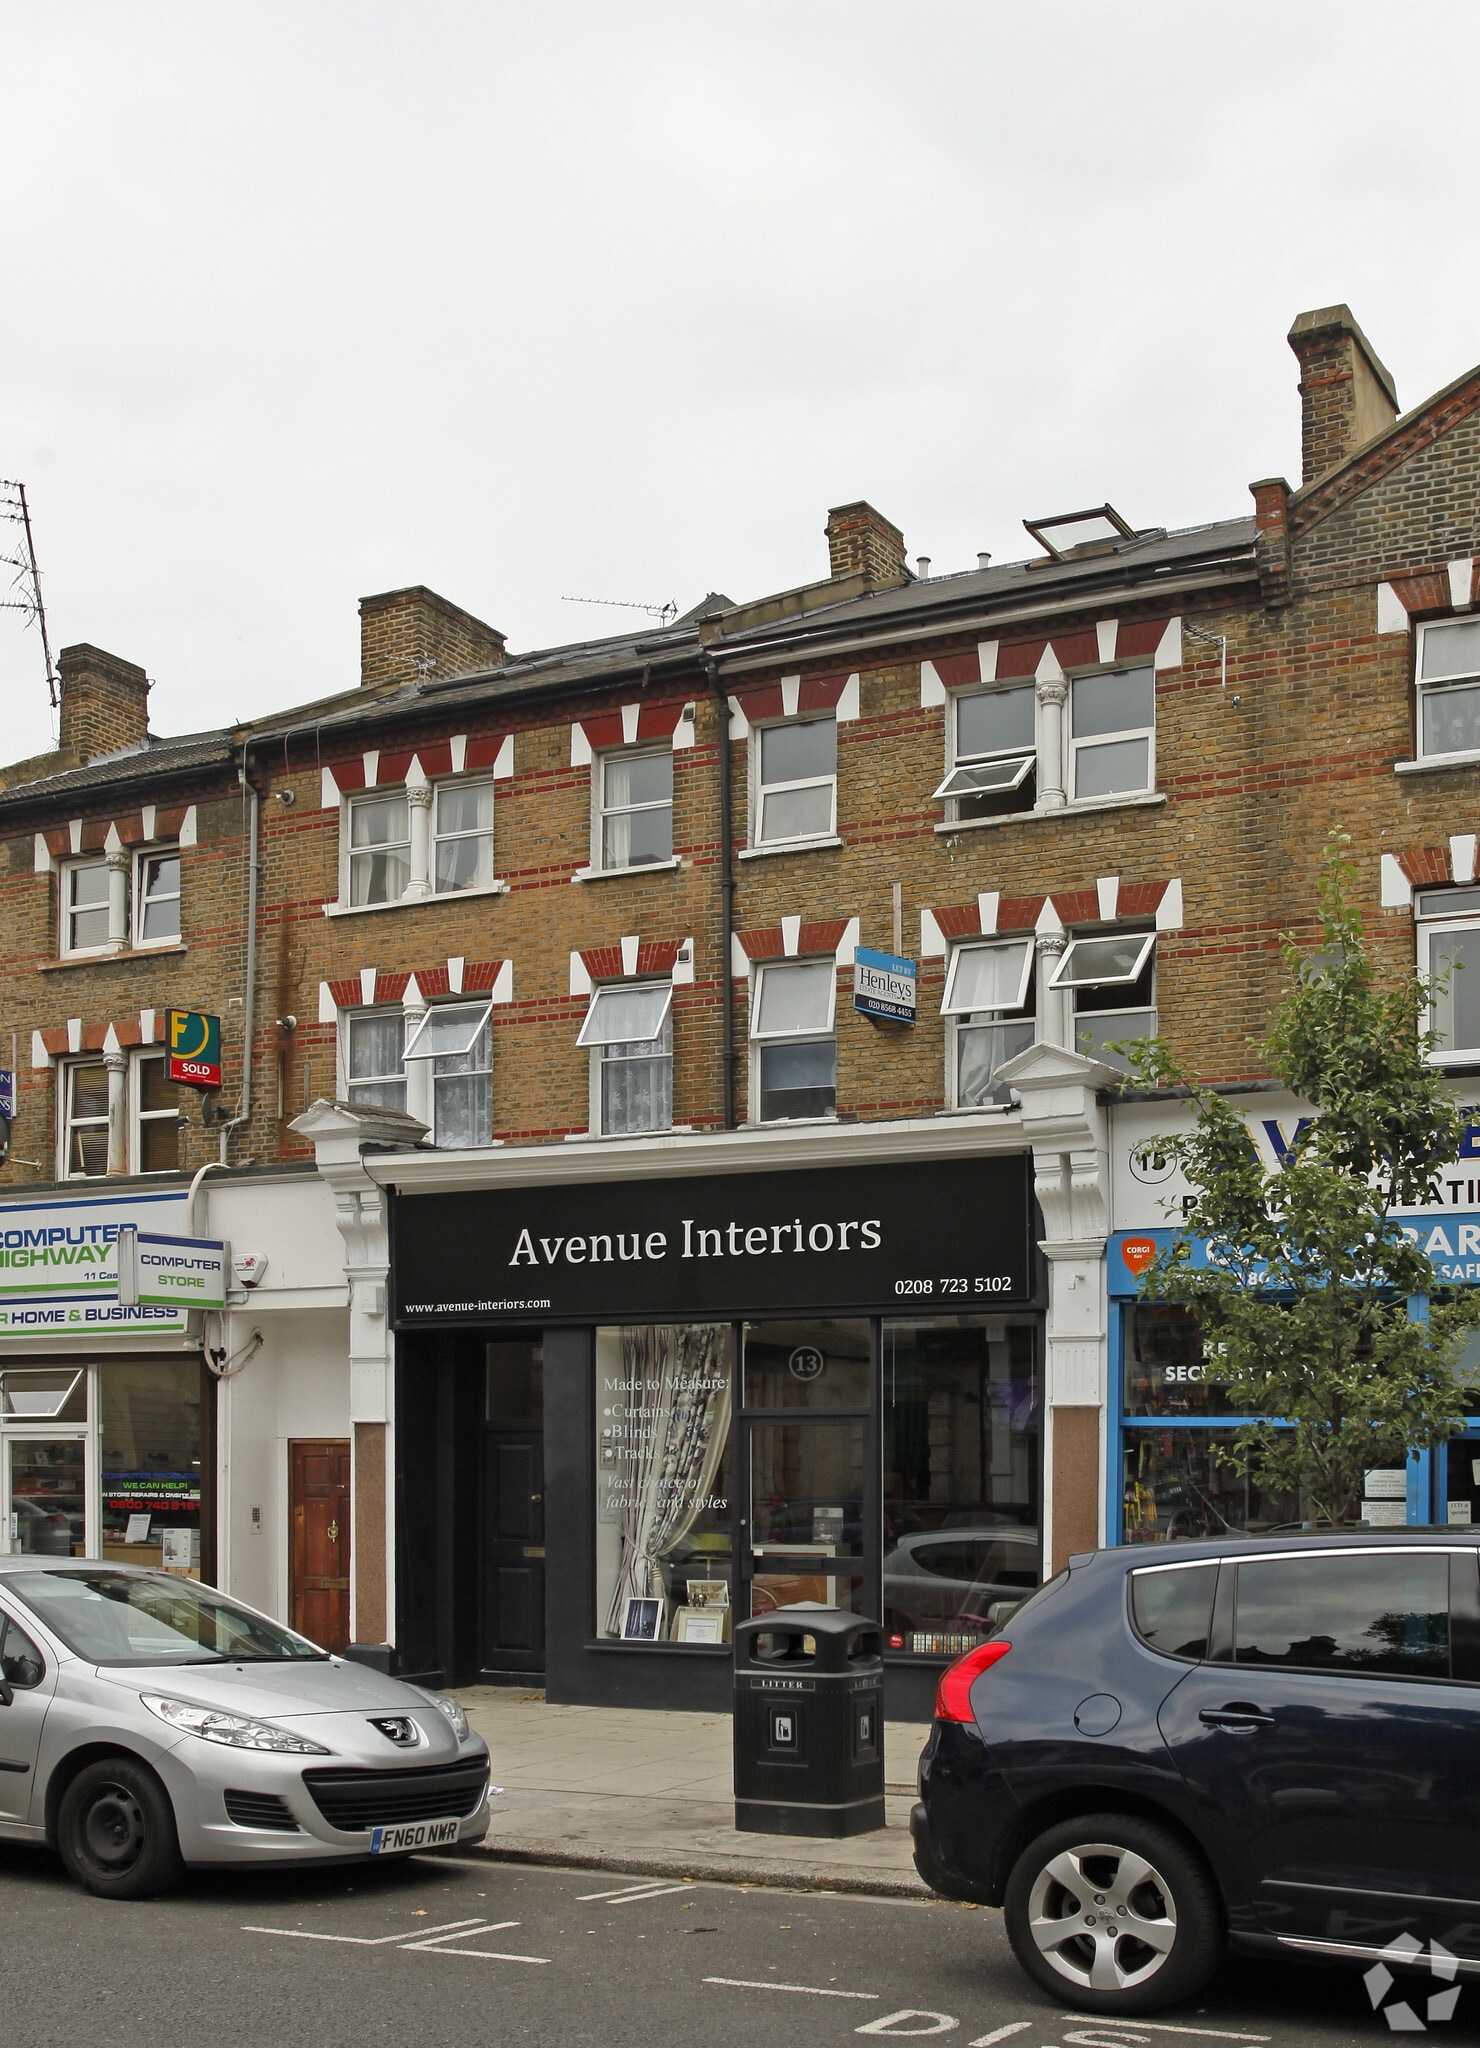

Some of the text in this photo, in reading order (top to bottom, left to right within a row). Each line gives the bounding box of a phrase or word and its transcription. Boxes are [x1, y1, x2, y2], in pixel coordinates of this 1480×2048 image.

[860, 967, 912, 1000] Henleys
[868, 999, 880, 1010] 020
[182, 1062, 210, 1075] SOLD
[508, 1217, 882, 1266] Avenue Interiors
[0, 1244, 113, 1268] IGHWAY
[1126, 1246, 1150, 1254] CORGI
[140, 1254, 221, 1271] COMPUTER
[84, 1272, 96, 1280] 11
[158, 1274, 205, 1288] STORE
[894, 1276, 1012, 1295] 0208 723 5102
[405, 1298, 551, 1313] www.avenue-interiors.com
[11, 1310, 66, 1325] HOME
[68, 1309, 82, 1322] &
[85, 1306, 179, 1321] BUSINESS
[795, 1355, 817, 1372] 13
[603, 1376, 729, 1391] Made to Measure:
[612, 1424, 658, 1439] Blinds
[614, 1445, 660, 1460] Tracks
[109, 1500, 143, 1509] 0800
[145, 1501, 169, 1510] 740
[687, 1494, 728, 1513] styles
[762, 1680, 803, 1689] LITTER
[382, 1822, 457, 1849] FN60 NWR
